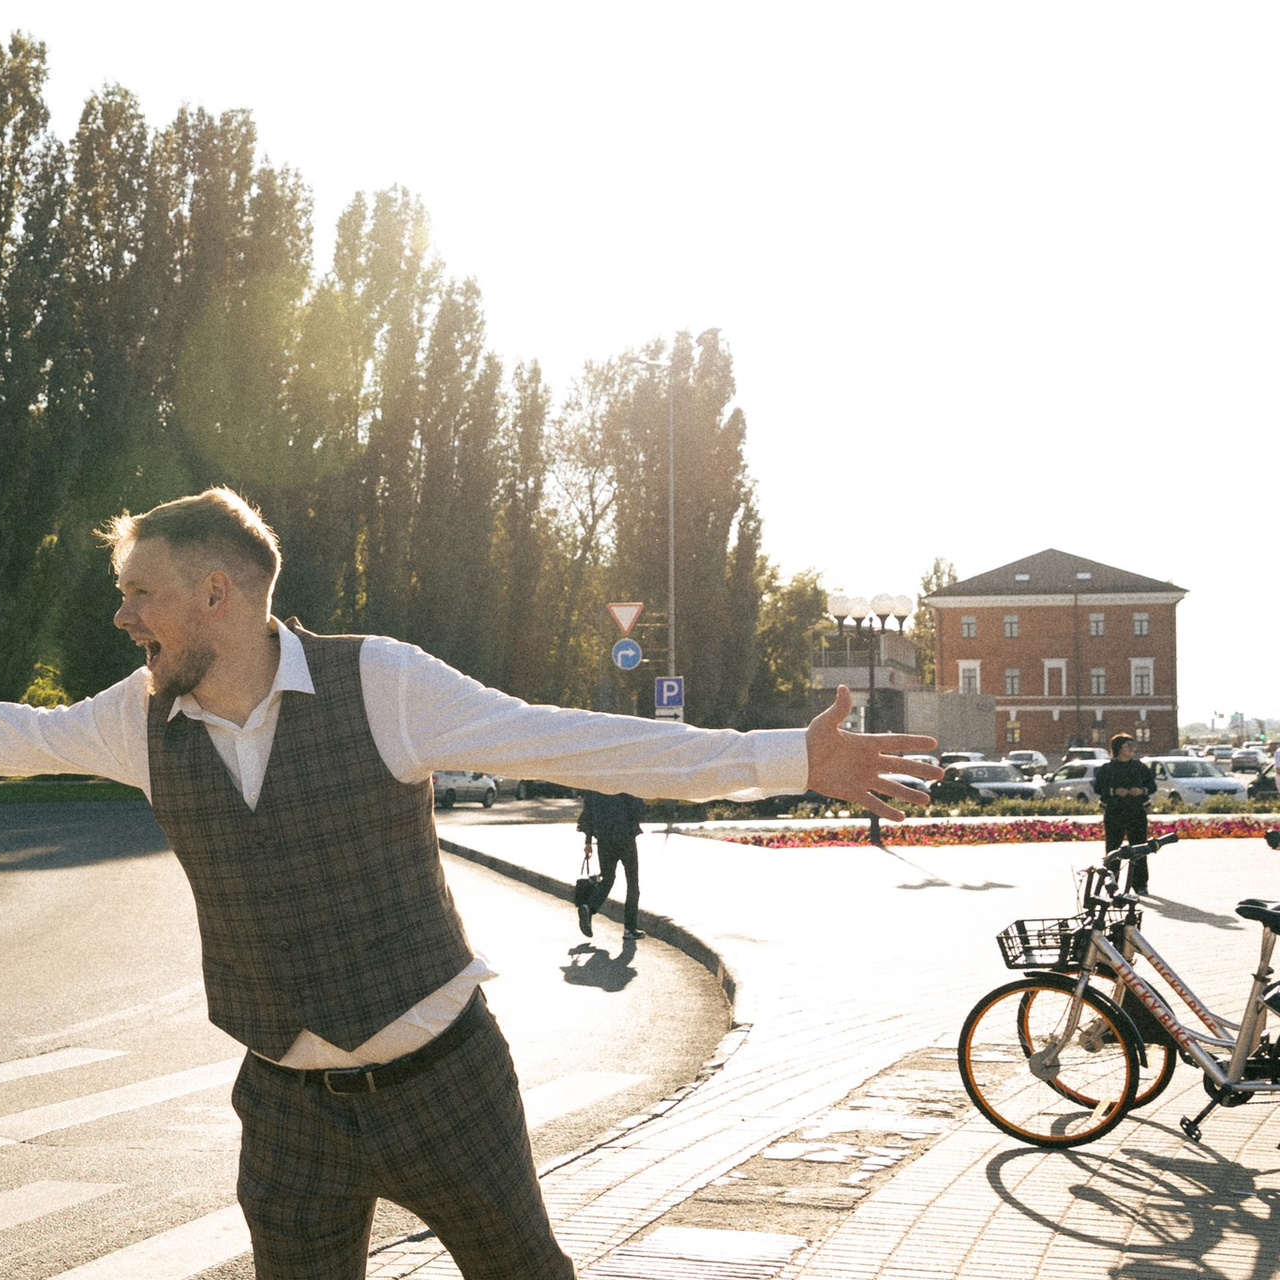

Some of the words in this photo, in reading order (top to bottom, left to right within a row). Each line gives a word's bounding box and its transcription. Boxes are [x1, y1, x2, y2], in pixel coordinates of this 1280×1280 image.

[663, 680, 679, 705] P
[1114, 963, 1162, 1011] LUCKY
[1159, 1012, 1194, 1047] BIKE
[1147, 954, 1189, 998] LUCKY
[1187, 999, 1218, 1031] BIKE
